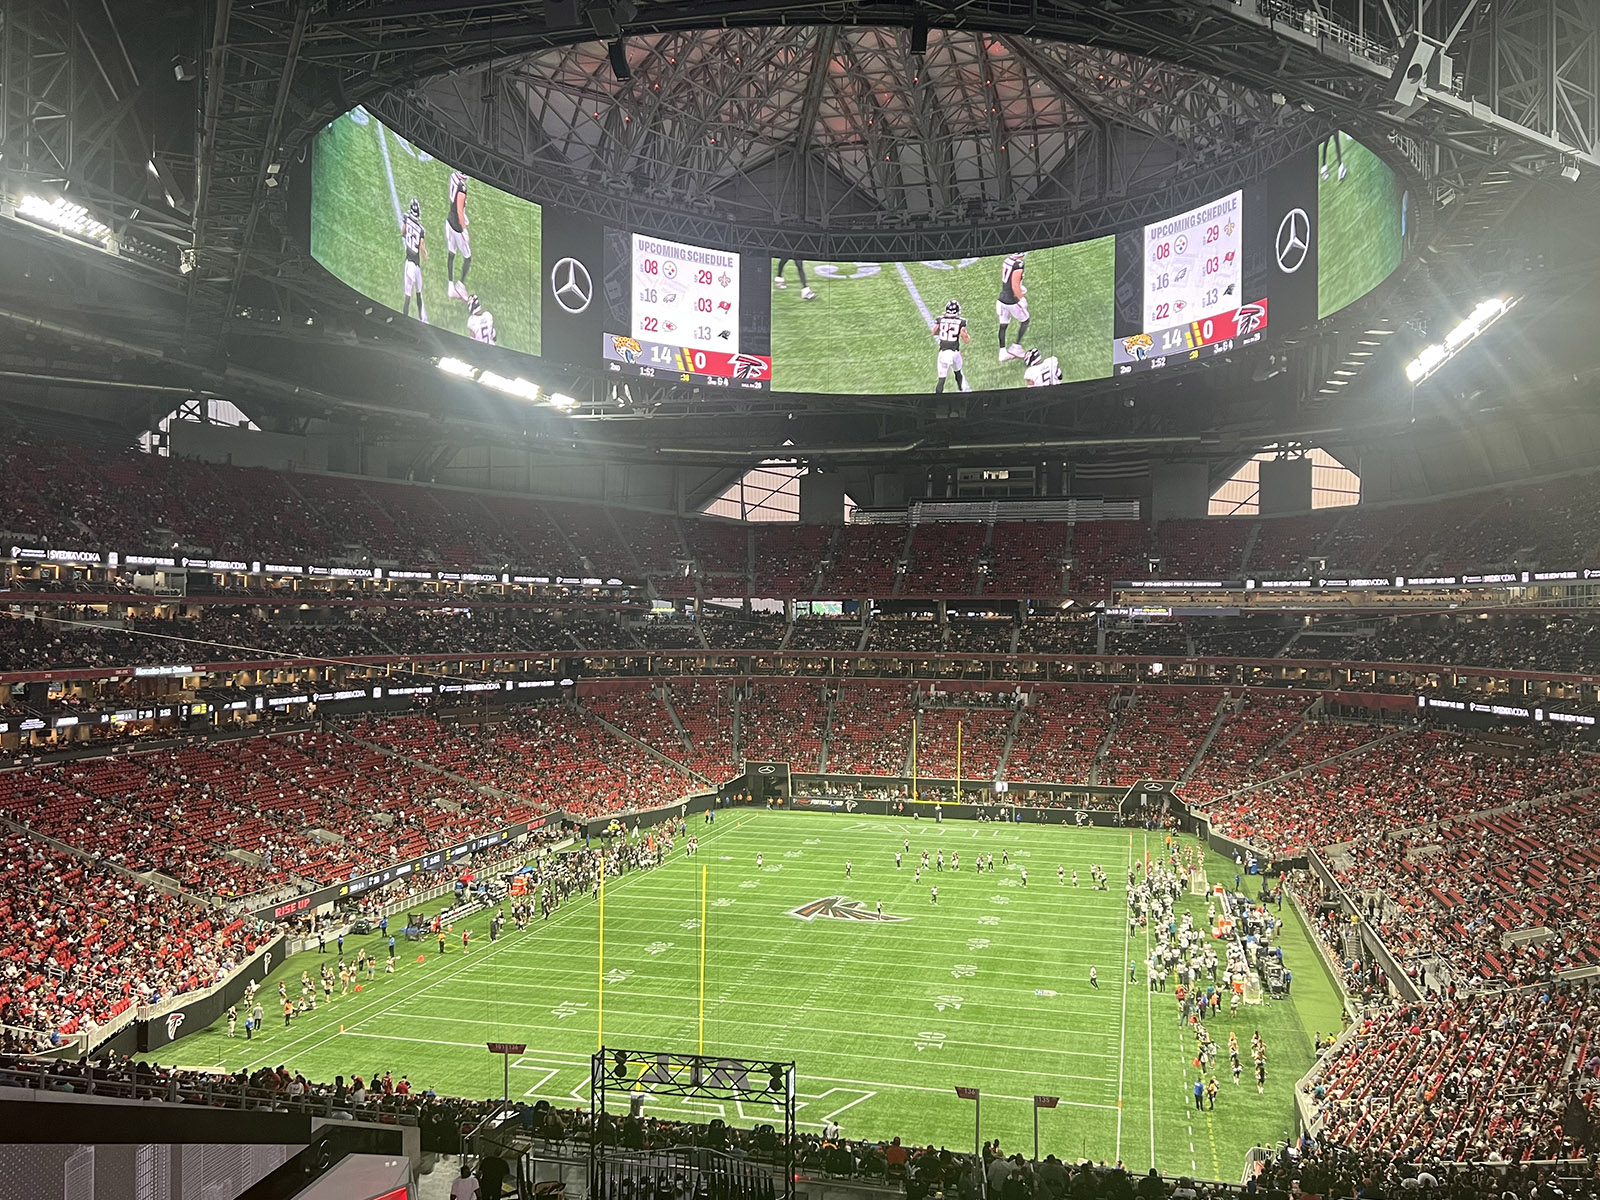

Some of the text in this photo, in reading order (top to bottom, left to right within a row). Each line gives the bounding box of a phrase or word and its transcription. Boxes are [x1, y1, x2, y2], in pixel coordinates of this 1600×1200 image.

[1151, 198, 1238, 240] UPCOMING SCHEDULE
[1206, 225, 1219, 244] 29
[638, 240, 733, 268] UPCOMING SCHEDULE
[1156, 242, 1170, 260] 08
[644, 259, 658, 275] 08
[1206, 257, 1219, 274] 03
[698, 270, 712, 285] 29
[1156, 273, 1169, 290] 16
[644, 288, 657, 303] 16
[1206, 288, 1218, 307] 13
[698, 298, 712, 313] 03
[1156, 303, 1169, 320] 22
[644, 316, 658, 332] 22
[939, 324, 960, 341] 82
[698, 326, 711, 340] 13
[1162, 320, 1213, 349] 14 0
[651, 346, 706, 369] 14 0
[640, 367, 655, 377] 1:52
[275, 898, 311, 918] RISE UP
[914, 1032, 946, 1049] 10
